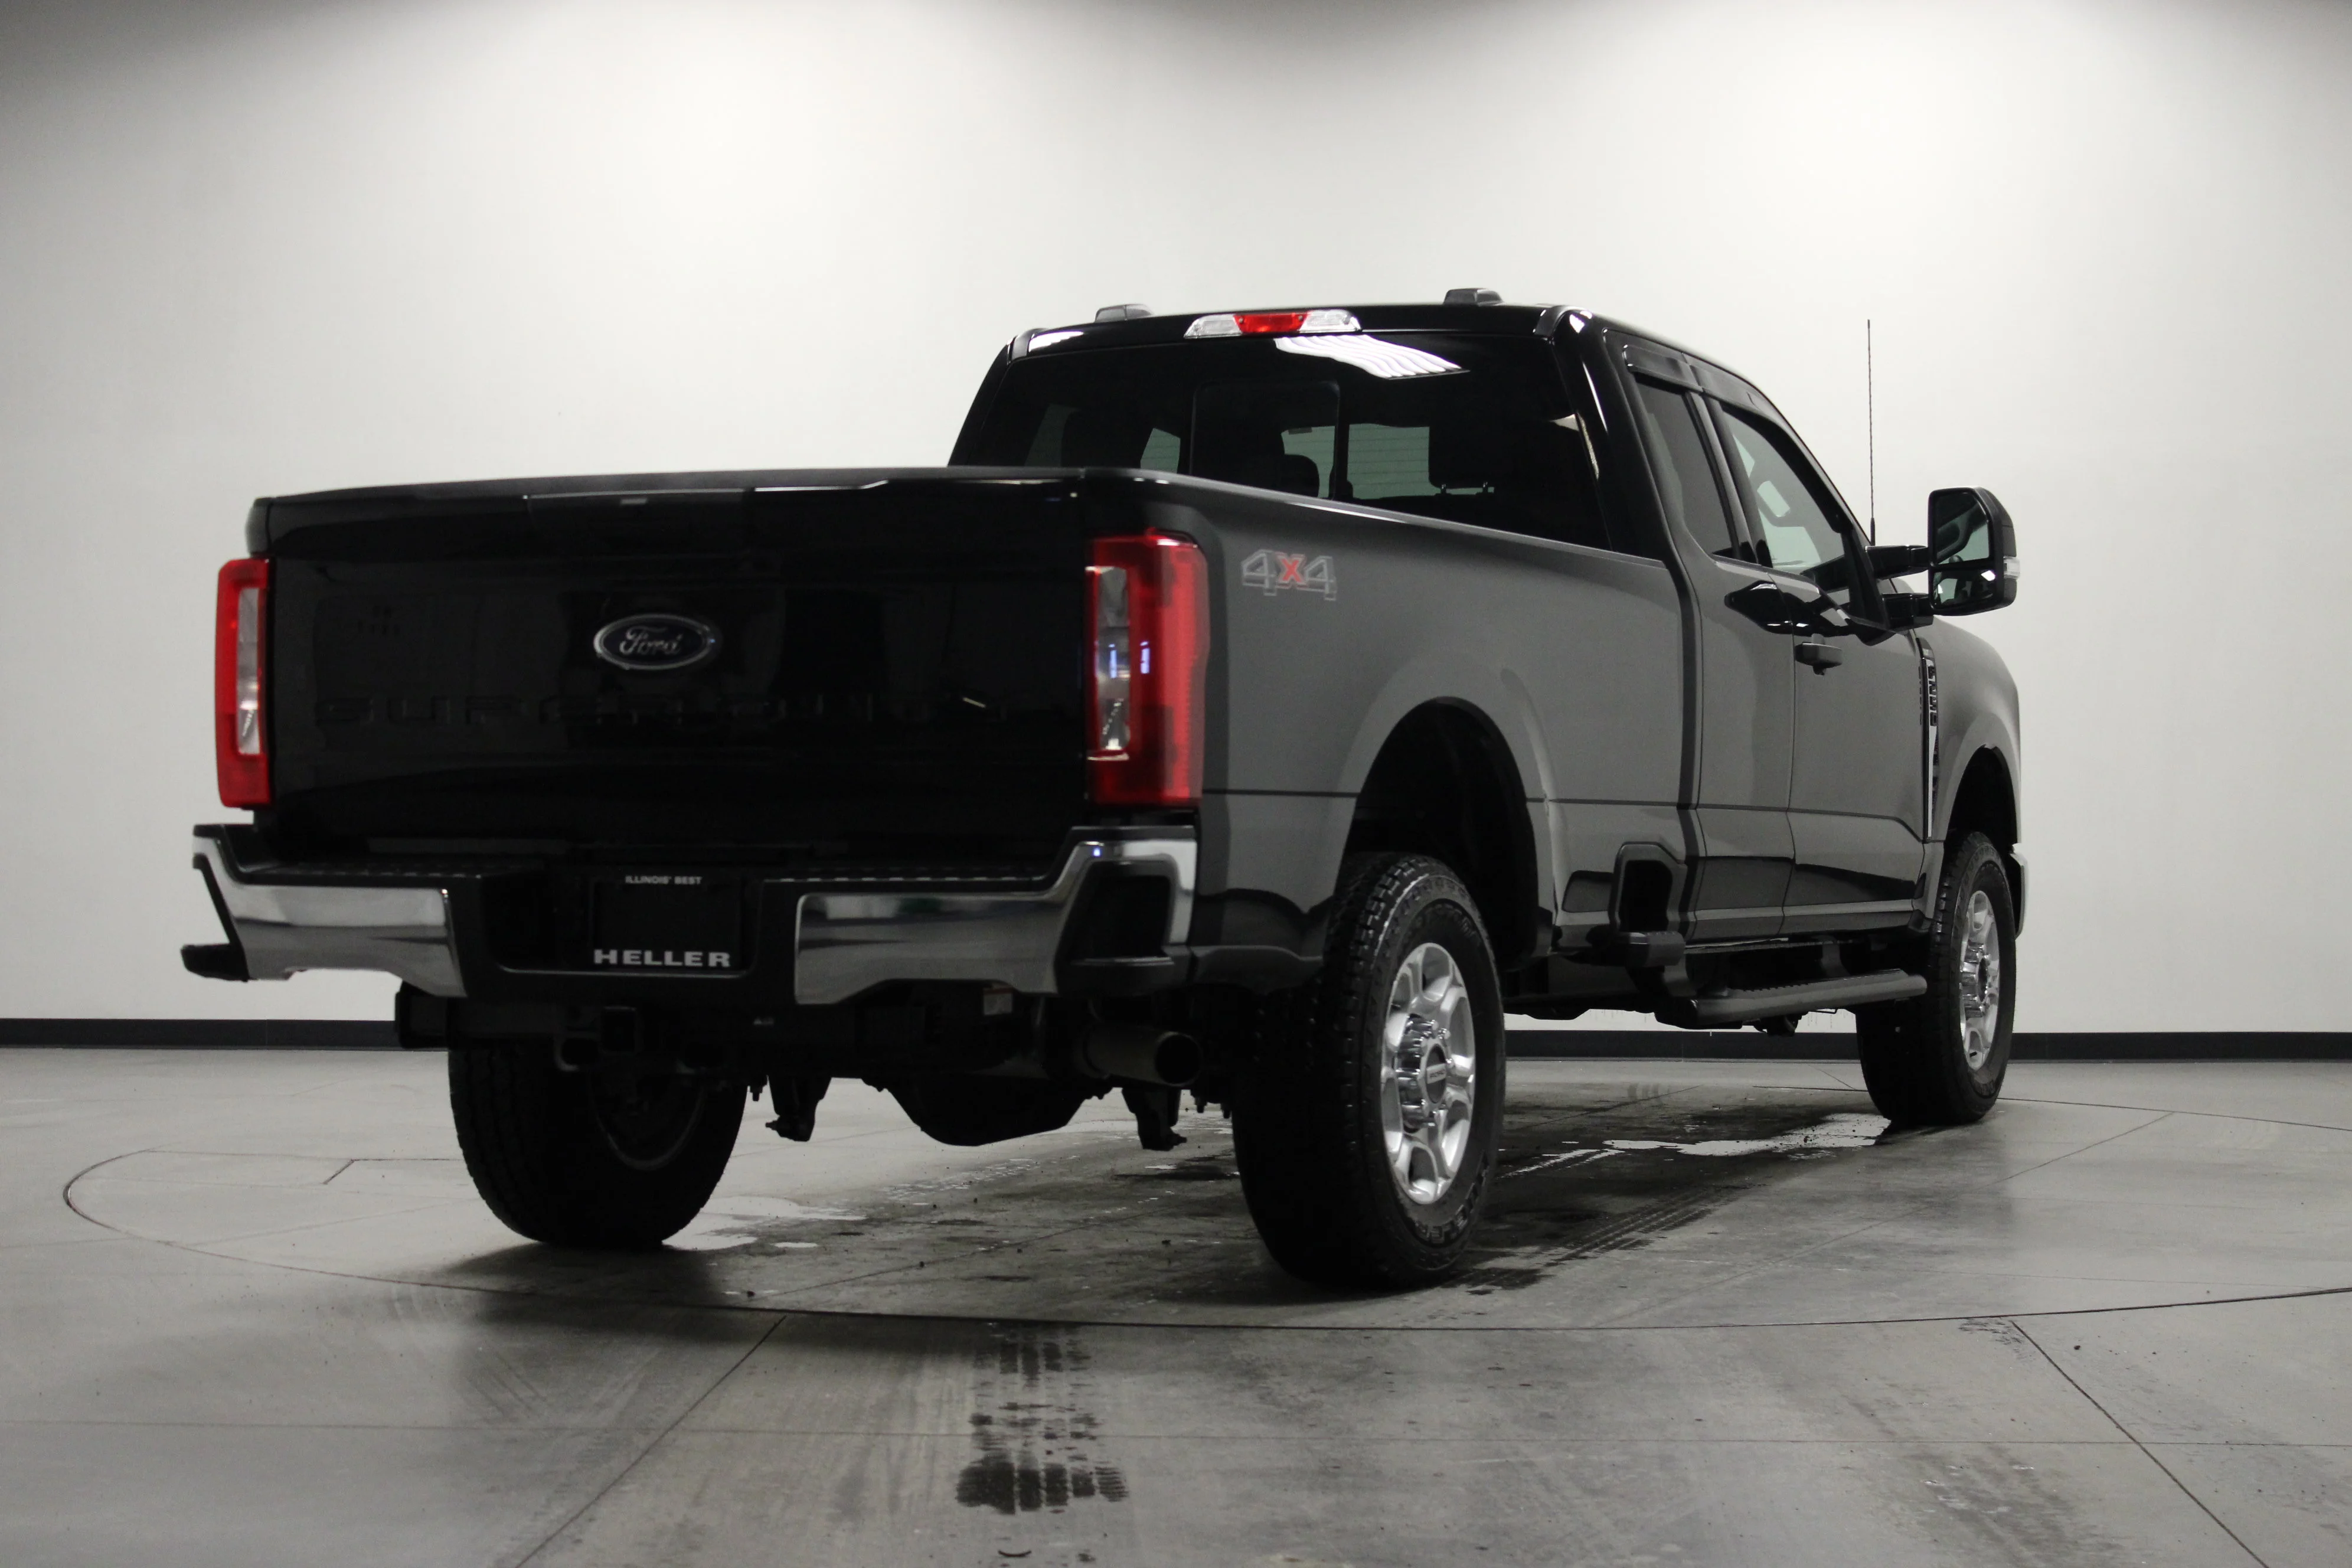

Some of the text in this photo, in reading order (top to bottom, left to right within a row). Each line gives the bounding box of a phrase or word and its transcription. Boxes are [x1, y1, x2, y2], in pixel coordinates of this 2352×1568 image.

[619, 625, 685, 655] Ford
[674, 876, 704, 885] BEST
[593, 949, 731, 968] HELLER
